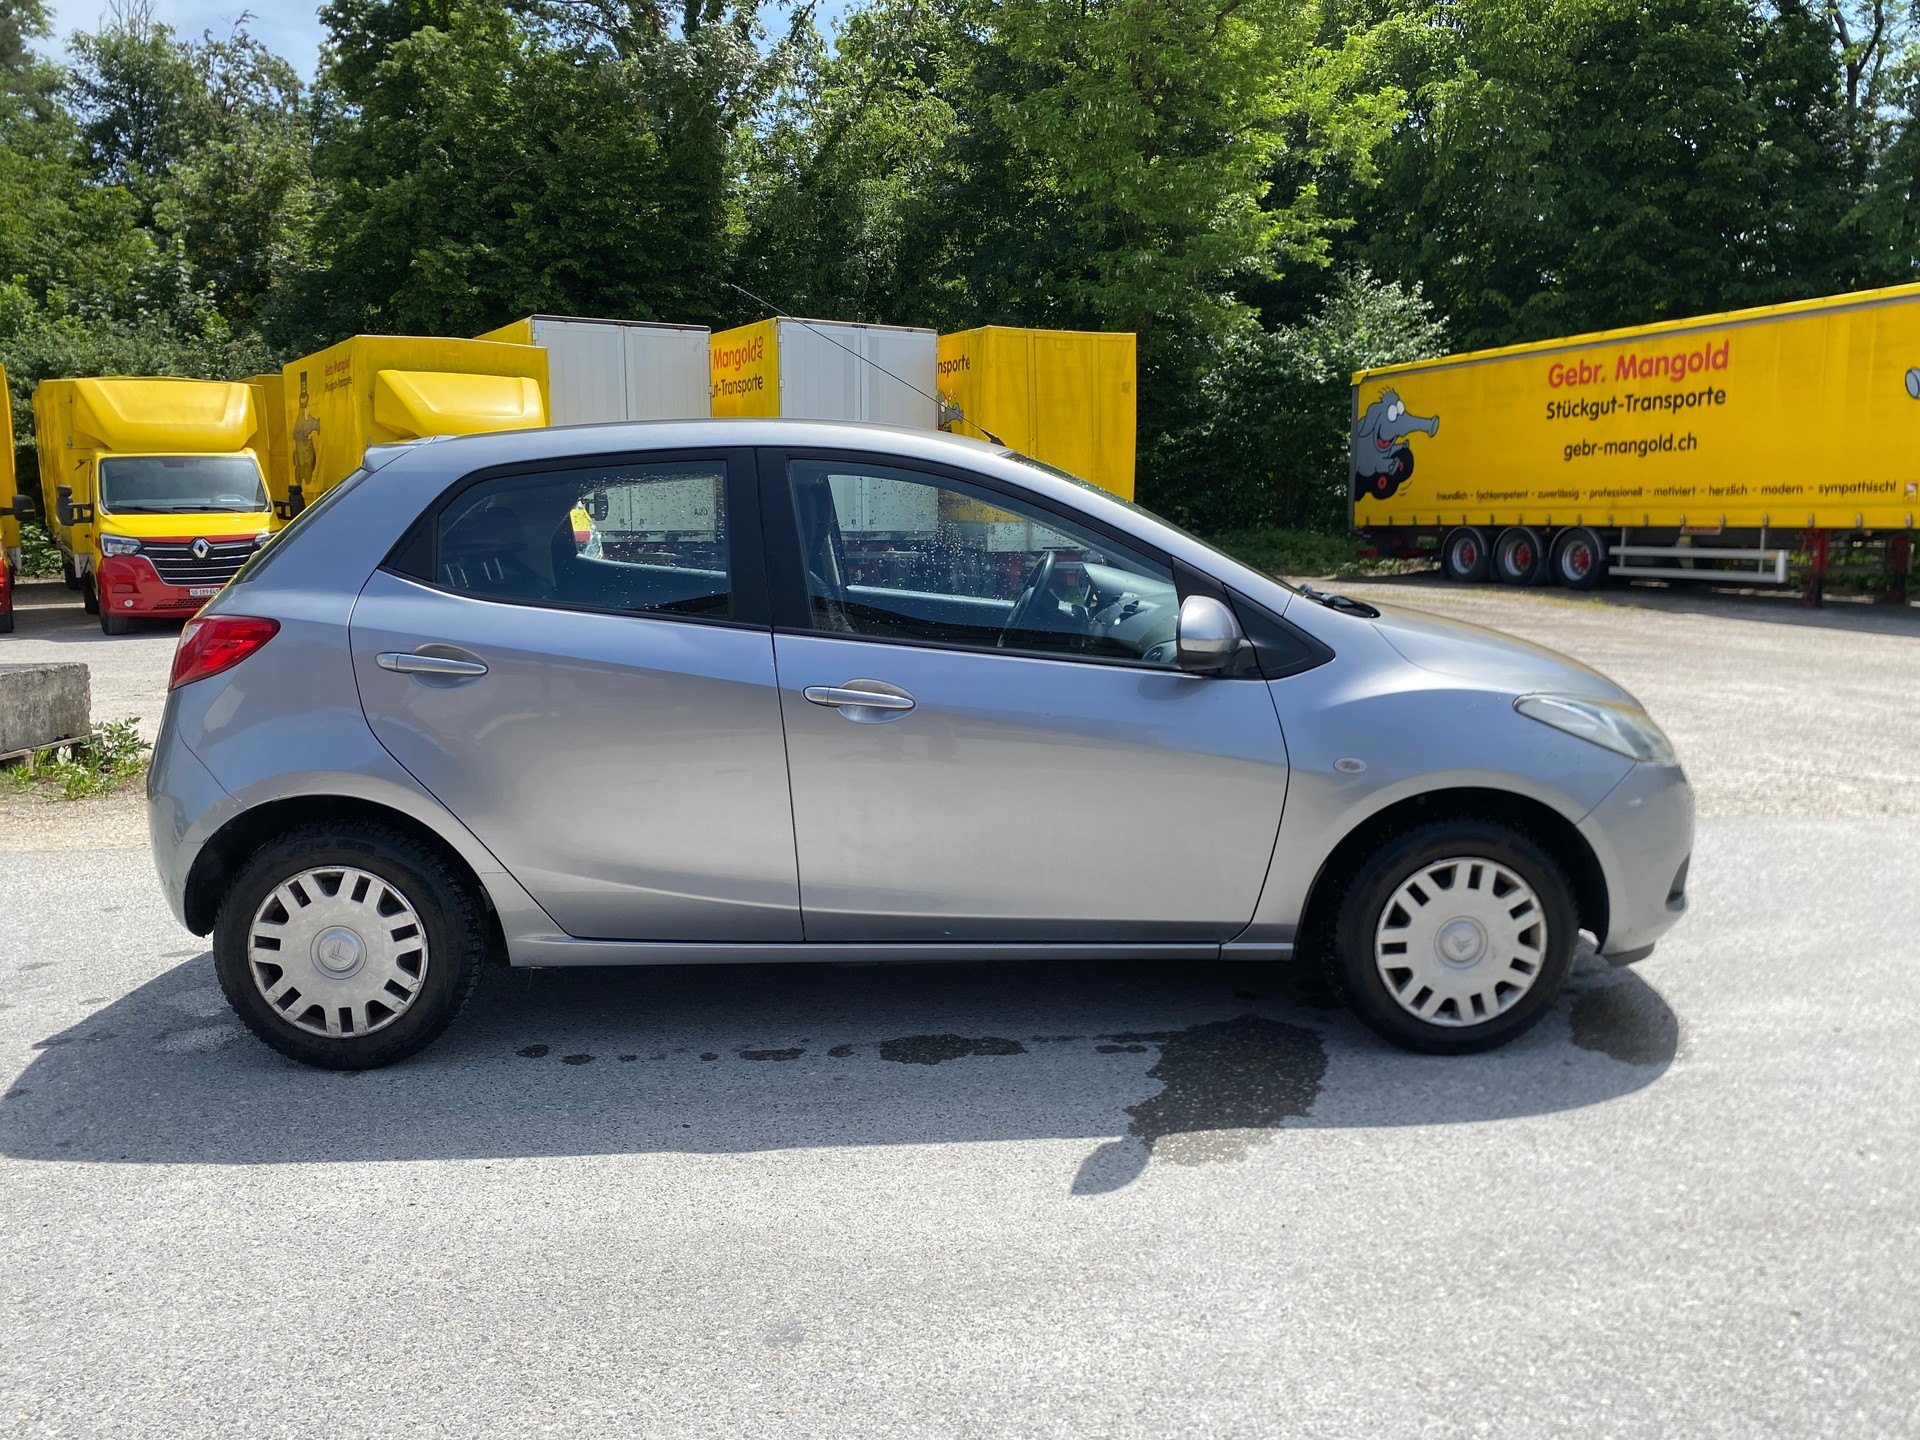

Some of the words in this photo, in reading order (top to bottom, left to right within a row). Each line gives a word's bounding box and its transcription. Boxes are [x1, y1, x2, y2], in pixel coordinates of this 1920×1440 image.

[713, 338, 757, 372] Mangold
[757, 335, 764, 359] AG
[937, 353, 970, 378] nsporte
[1548, 359, 1606, 388] Gebr.
[1615, 339, 1730, 382] Mangold
[1546, 386, 1727, 421] Stückgut-Transporte
[1563, 432, 1698, 461] gebr-mangold.ch
[1436, 491, 1468, 501] freundlich
[1476, 490, 1529, 502] fachkompetent
[1537, 488, 1580, 501] zuverlässig
[1590, 485, 1643, 500] professionell
[1653, 484, 1697, 497] motiviert
[1708, 483, 1748, 497] herzlich
[1761, 482, 1804, 495] modern
[1818, 479, 1897, 498] sympathisch!
